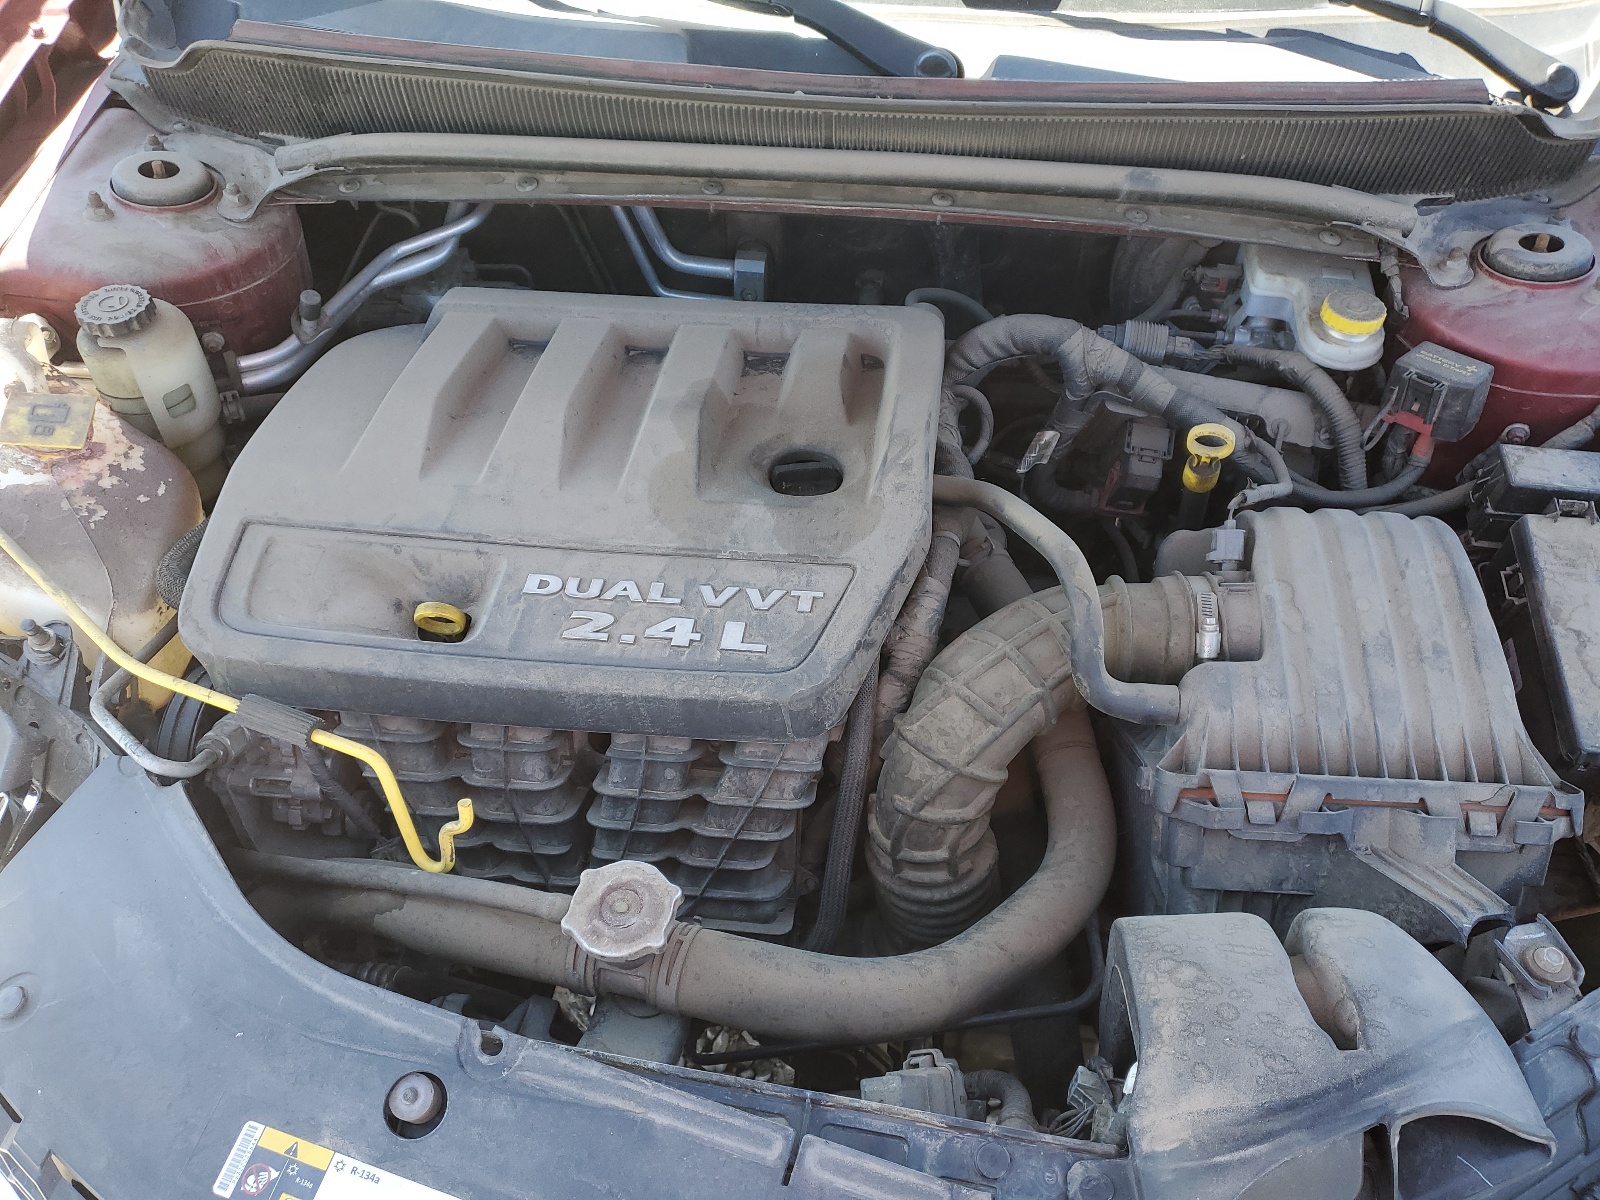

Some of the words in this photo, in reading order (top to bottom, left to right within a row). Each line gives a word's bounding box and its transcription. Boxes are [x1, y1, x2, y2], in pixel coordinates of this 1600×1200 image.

[522, 573, 682, 606] DUAL
[699, 584, 824, 613] VVT
[561, 610, 702, 648] 2.4
[719, 621, 769, 653] L
[350, 1166, 380, 1184] R-134a
